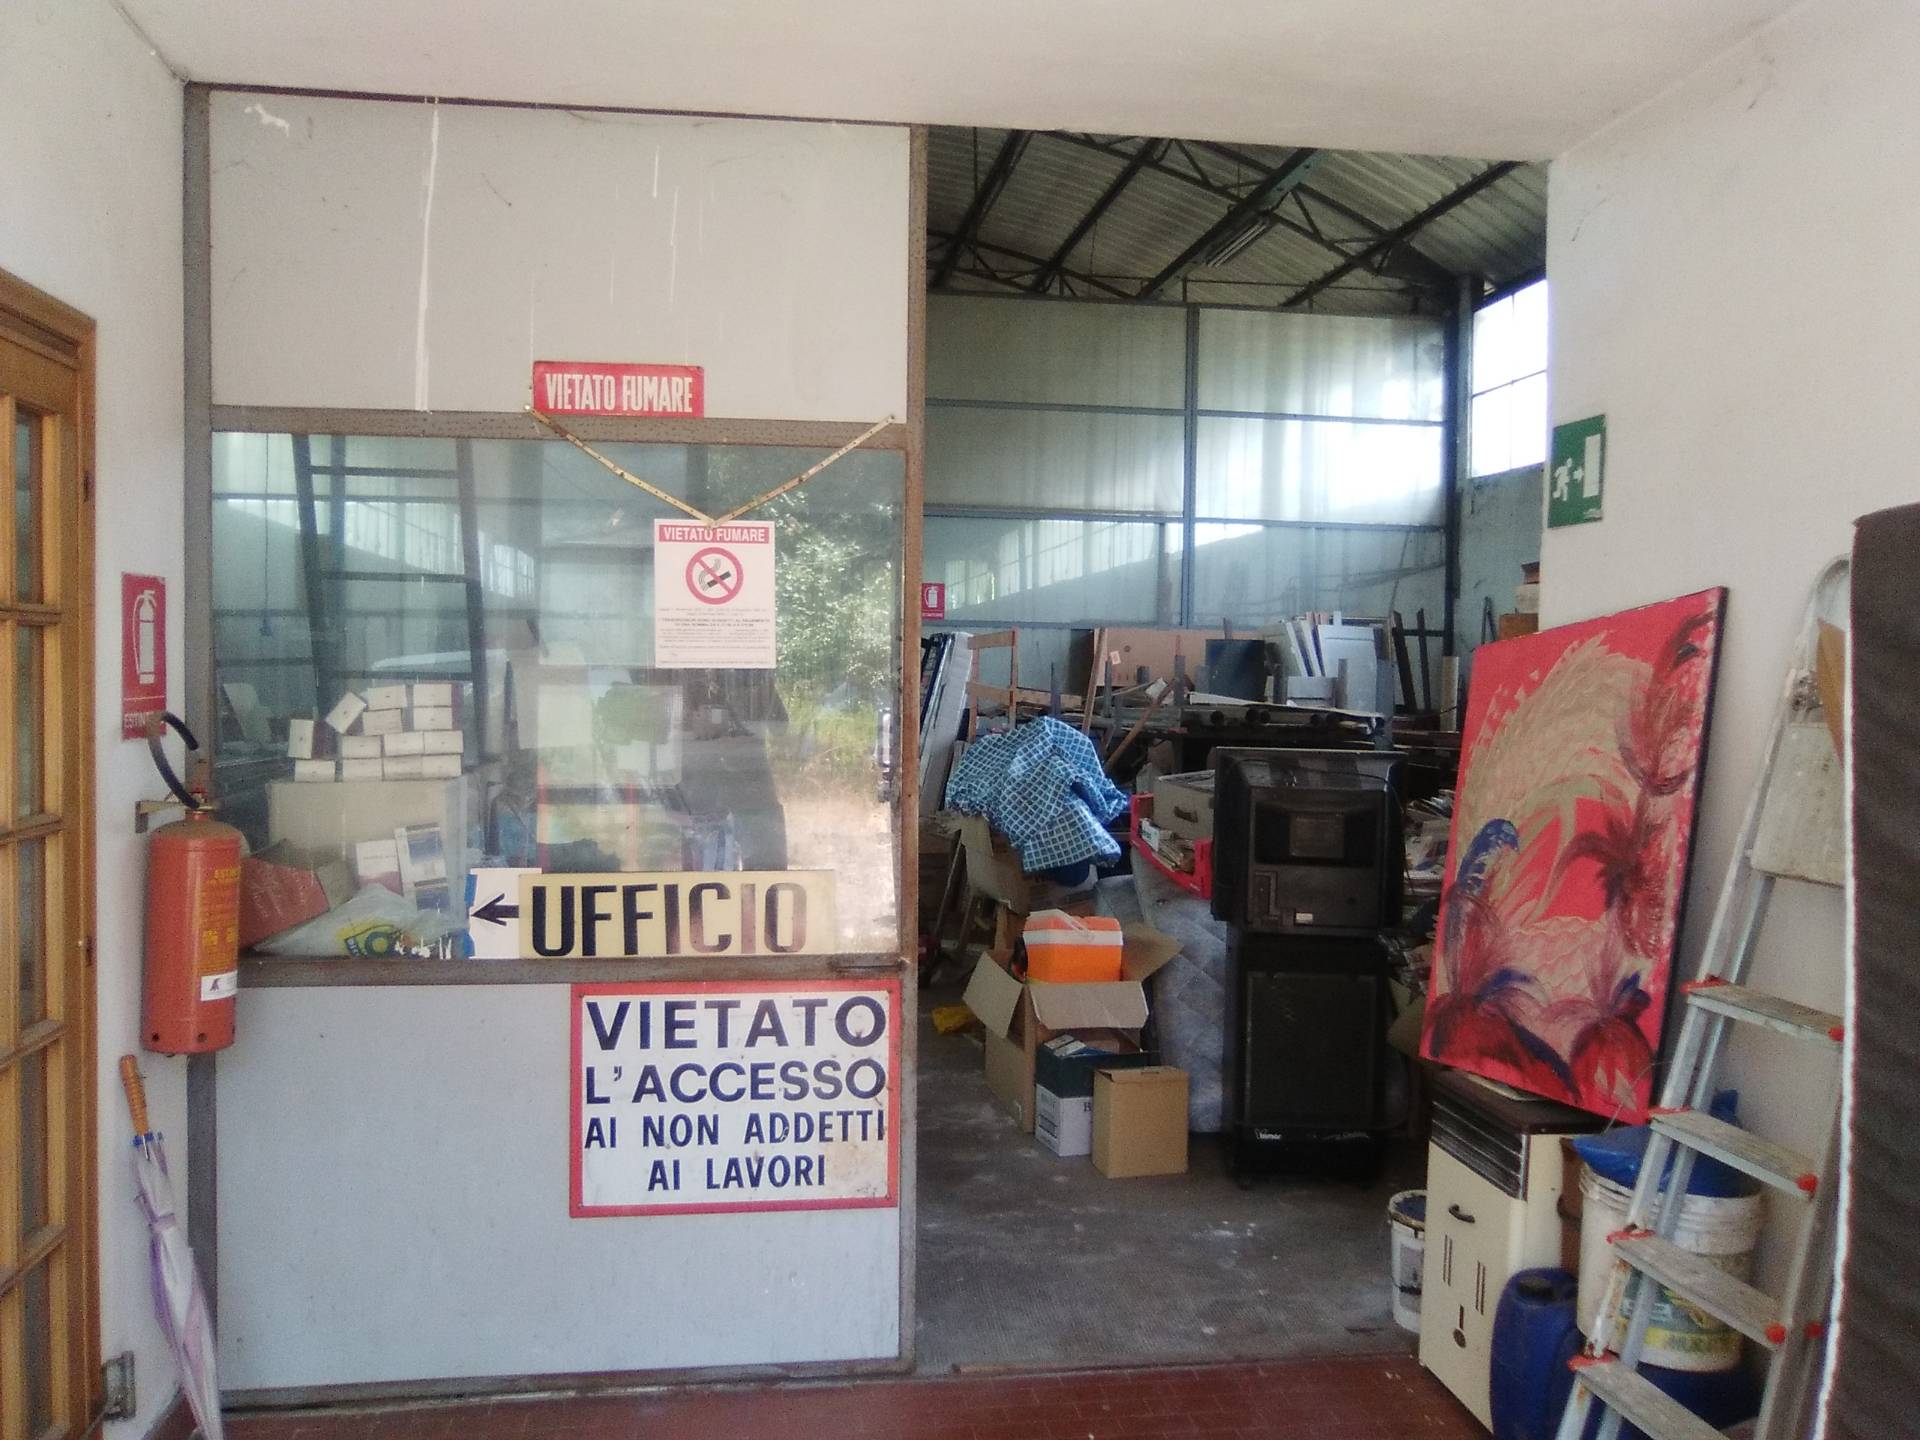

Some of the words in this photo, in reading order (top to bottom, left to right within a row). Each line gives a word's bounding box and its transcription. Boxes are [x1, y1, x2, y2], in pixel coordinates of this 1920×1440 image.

[545, 373, 616, 410] VIETATO
[622, 375, 693, 413] FUMARE
[663, 526, 713, 541] VIETATO
[716, 528, 765, 542] FUMARE
[532, 882, 807, 957] UFFICIO
[586, 995, 887, 1051] VIETATO
[585, 1116, 617, 1149] AI
[642, 1113, 719, 1147] NON
[744, 1109, 885, 1144] ADDETTI
[648, 1159, 681, 1192] AI
[706, 1154, 825, 1190] LAVORI
